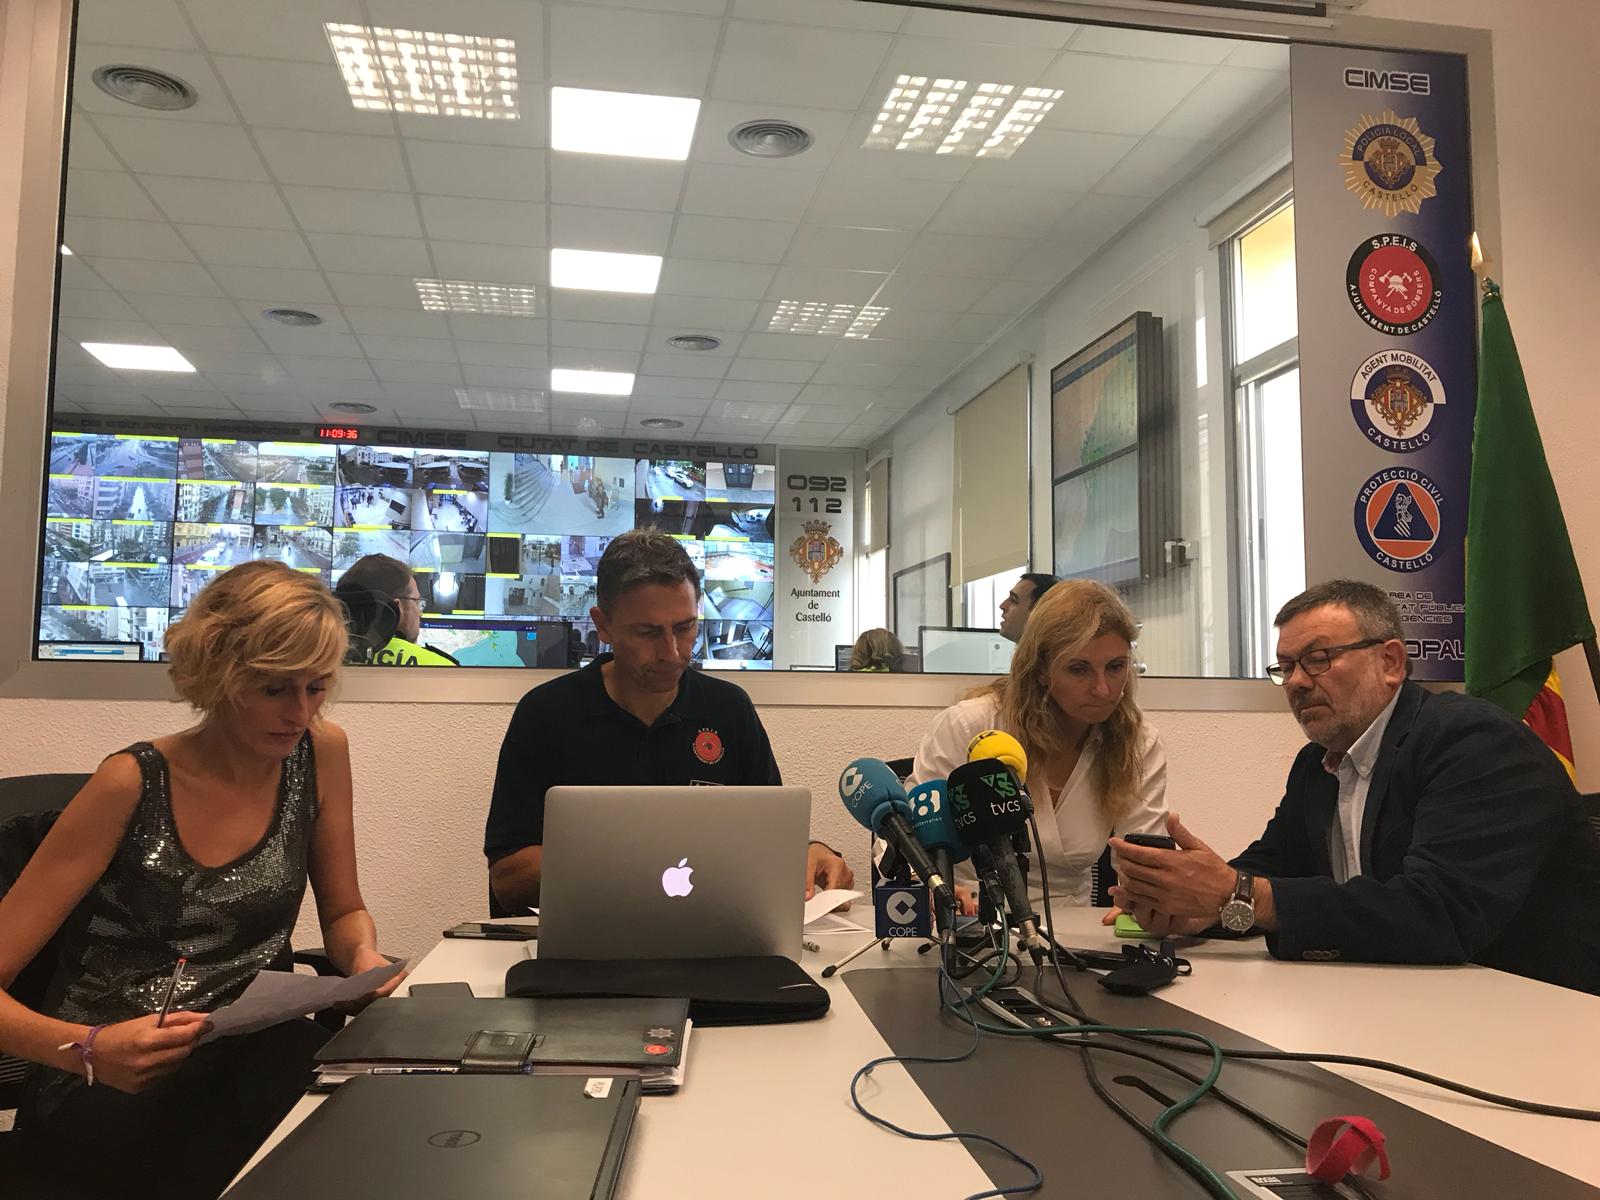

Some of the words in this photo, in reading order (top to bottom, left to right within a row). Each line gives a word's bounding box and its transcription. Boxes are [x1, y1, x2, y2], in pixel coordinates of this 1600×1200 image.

[1344, 68, 1430, 95] CIMSE
[1394, 129, 1420, 154] LOCAL
[1369, 268, 1391, 313] COMPANYA
[1406, 270, 1423, 311] BOMBERS
[1350, 284, 1395, 333] AJUNTAMENT
[1361, 354, 1388, 380] AGENT
[1391, 353, 1437, 382] MOBILITAT
[377, 429, 467, 447] CIMSE
[497, 435, 578, 451] CIUTAT
[586, 440, 618, 452] DE
[787, 474, 847, 492] 092
[1360, 470, 1418, 503] PROTECCIÓ
[1421, 478, 1443, 506] CIVIL
[792, 496, 842, 514] 112
[790, 588, 840, 599] Ajuntament
[1388, 591, 1413, 600] REA
[1415, 591, 1433, 600] DE
[807, 600, 819, 609] de
[1419, 601, 1465, 612] PÚBLIC
[795, 611, 832, 622] Castelló
[852, 780, 874, 808] COPE
[990, 799, 1021, 816] tvcs
[889, 926, 918, 937] COPE
